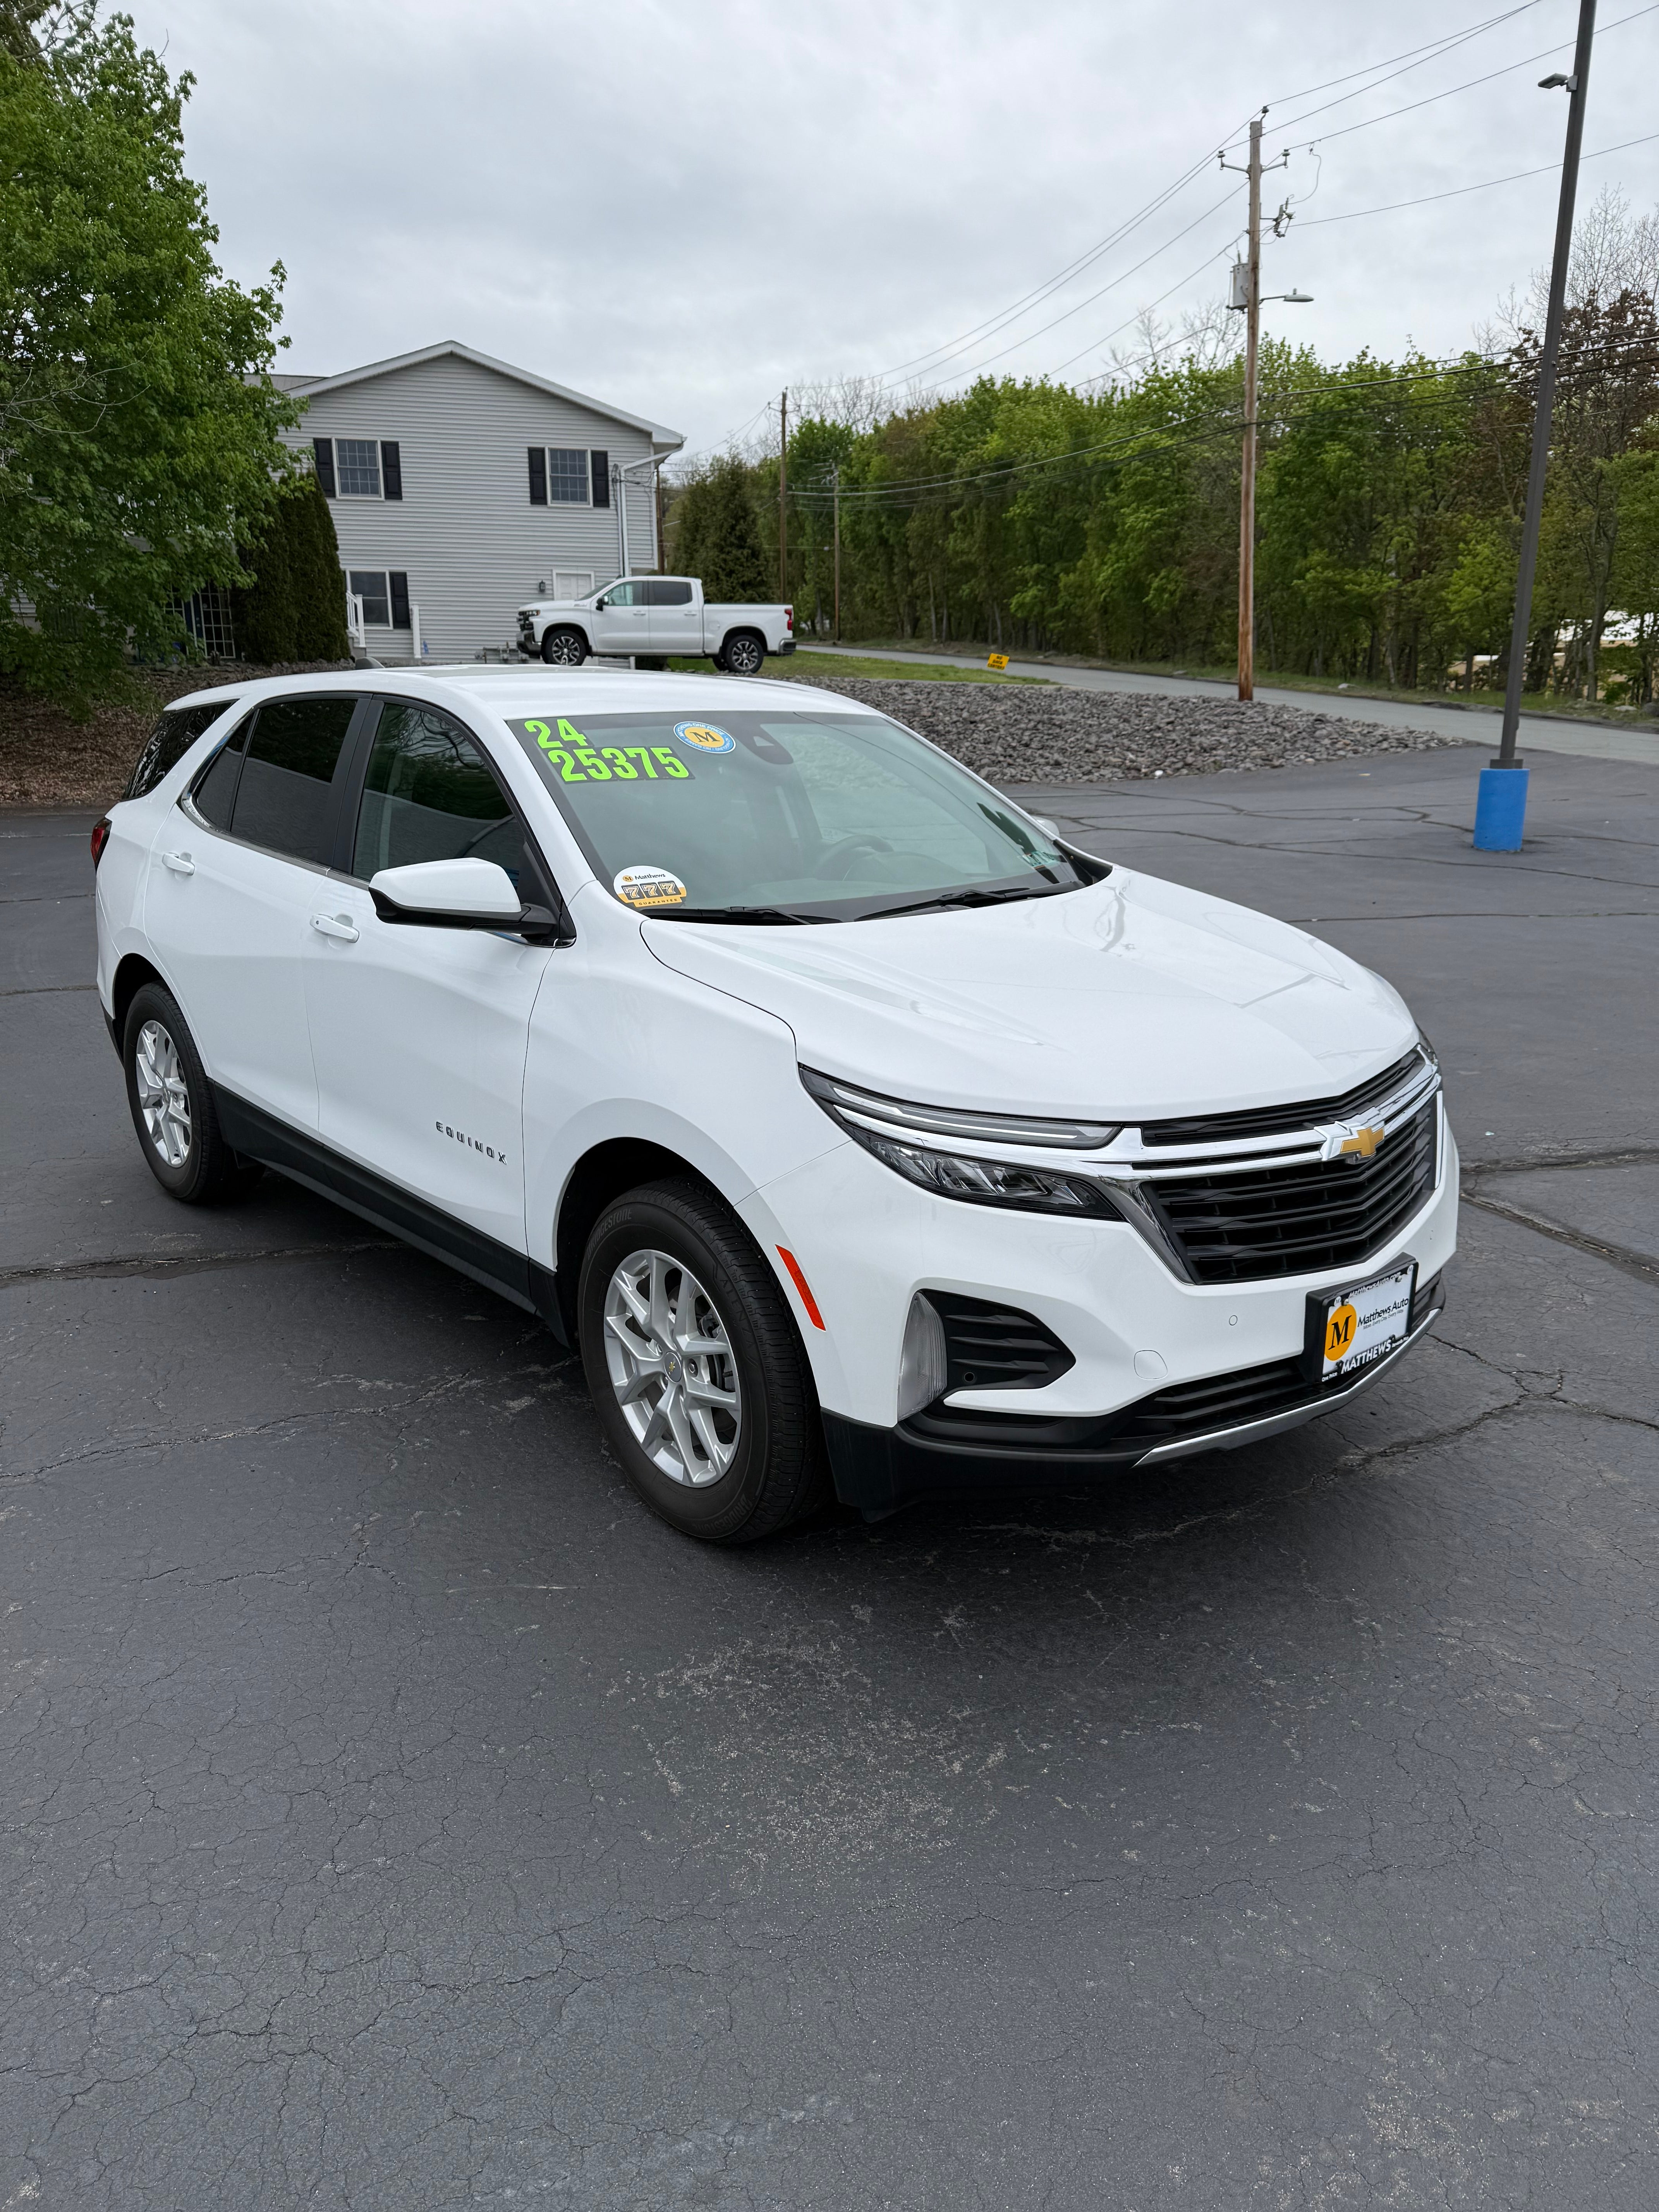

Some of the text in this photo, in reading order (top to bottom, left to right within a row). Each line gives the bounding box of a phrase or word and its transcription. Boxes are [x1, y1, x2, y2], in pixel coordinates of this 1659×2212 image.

[524, 719, 587, 748] 24
[690, 732, 720, 742] M
[548, 747, 689, 781] 25375
[436, 1121, 507, 1165] EQUINOX
[720, 1279, 754, 1348] ALENZA
[1357, 1298, 1409, 1328] Matthews Auto
[1328, 1315, 1352, 1350] M
[1341, 1339, 1391, 1374] MATTHEWS
